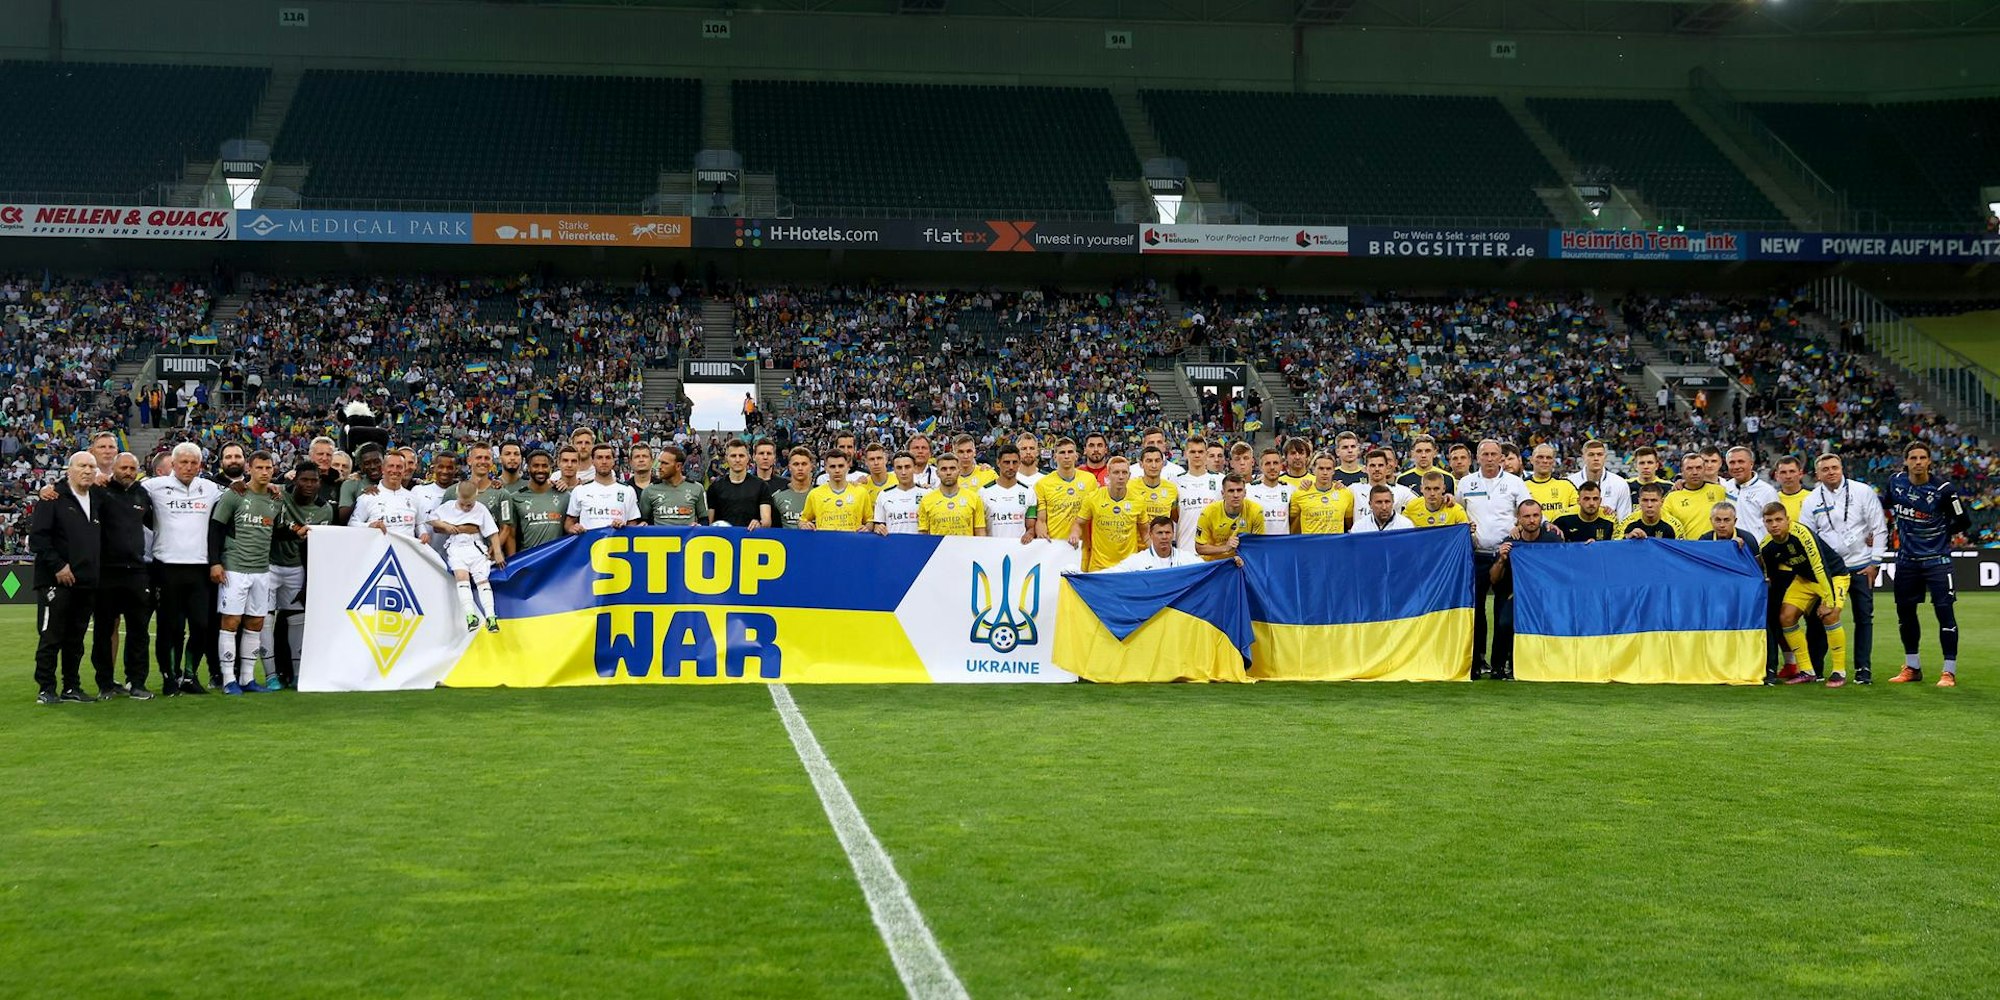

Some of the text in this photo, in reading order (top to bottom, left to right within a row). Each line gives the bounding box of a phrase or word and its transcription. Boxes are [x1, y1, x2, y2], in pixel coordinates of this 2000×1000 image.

[283, 12, 305, 21] 11A
[705, 24, 727, 33] 10A
[1111, 35, 1126, 44] 9A
[223, 161, 254, 172] PUMA
[698, 171, 727, 181] PUMA
[35, 207, 229, 227] NELLEN & QUACK
[288, 219, 468, 235] MEDICAL PARK
[558, 220, 589, 230] Starke
[657, 223, 680, 234] EGN
[558, 230, 619, 241] Viererkette.
[770, 226, 879, 241] H-Hotels.com
[923, 228, 988, 243] flatex
[1205, 233, 1289, 243] Your Project Partner
[1393, 231, 1510, 241] Der Wein & Sekt seit 1600
[1035, 233, 1134, 249] Invest in yourself
[1561, 231, 1643, 250] Heinrich
[1368, 241, 1535, 257] BROGSITTER.de
[1822, 238, 1886, 255] POWER
[1632, 251, 1670, 260] Baustoffe
[162, 358, 206, 373] PUMA
[690, 362, 731, 376] PUMA
[1186, 366, 1225, 380] PUMA
[166, 500, 208, 509] flatex
[1542, 502, 1563, 511] CENTR
[587, 506, 625, 517] flatex
[990, 512, 1024, 521] flatex
[1264, 509, 1287, 517] atex
[590, 536, 786, 596] STOP
[594, 611, 782, 679] WAR
[966, 660, 1040, 676] UKRAINE
